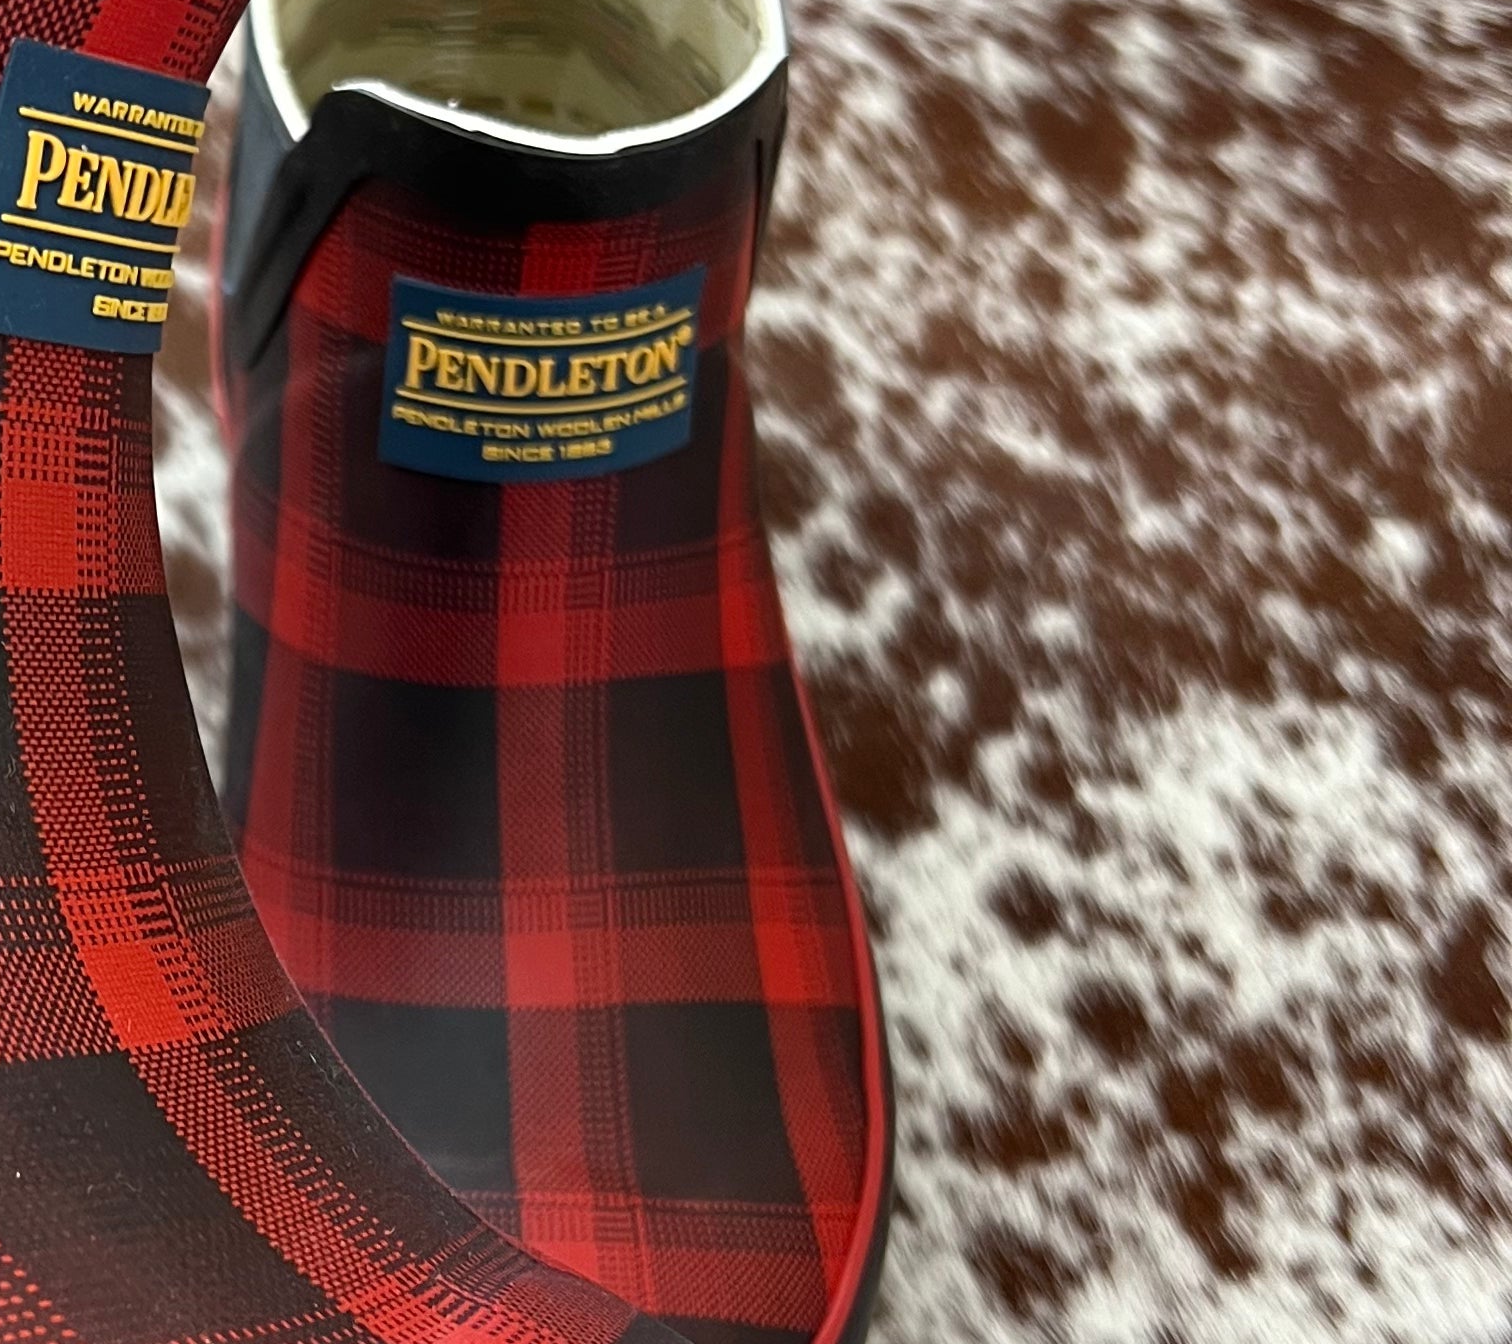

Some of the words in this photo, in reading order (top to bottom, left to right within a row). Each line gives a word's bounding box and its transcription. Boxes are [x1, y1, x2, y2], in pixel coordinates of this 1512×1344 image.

[92, 294, 147, 322] SINCE
[436, 310, 582, 335] WARRANTED
[590, 317, 618, 333] TO
[391, 405, 530, 439] PENDLETON
[536, 412, 631, 439] WOOLEN
[481, 444, 554, 462] SINCE
